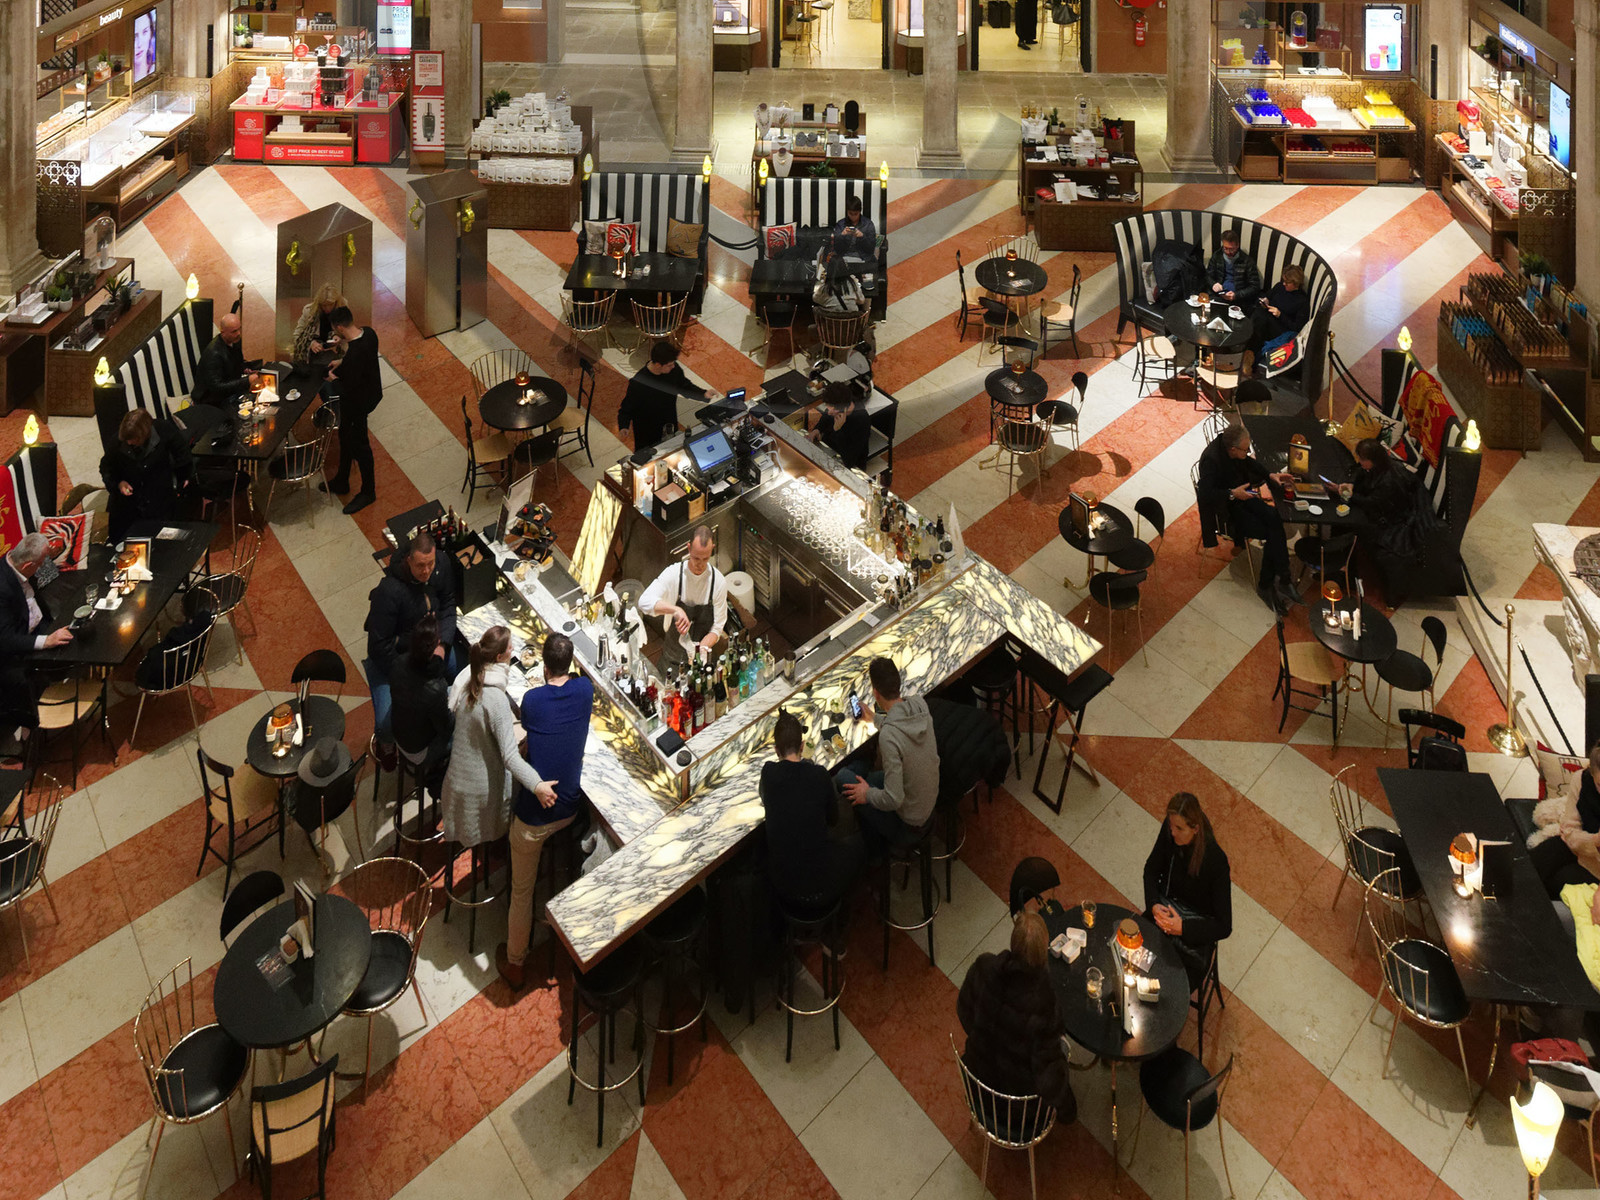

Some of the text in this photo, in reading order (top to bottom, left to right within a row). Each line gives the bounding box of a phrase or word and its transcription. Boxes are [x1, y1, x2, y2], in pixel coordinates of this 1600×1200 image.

[100, 7, 124, 26] beauty
[1501, 26, 1528, 54] italian gifts
